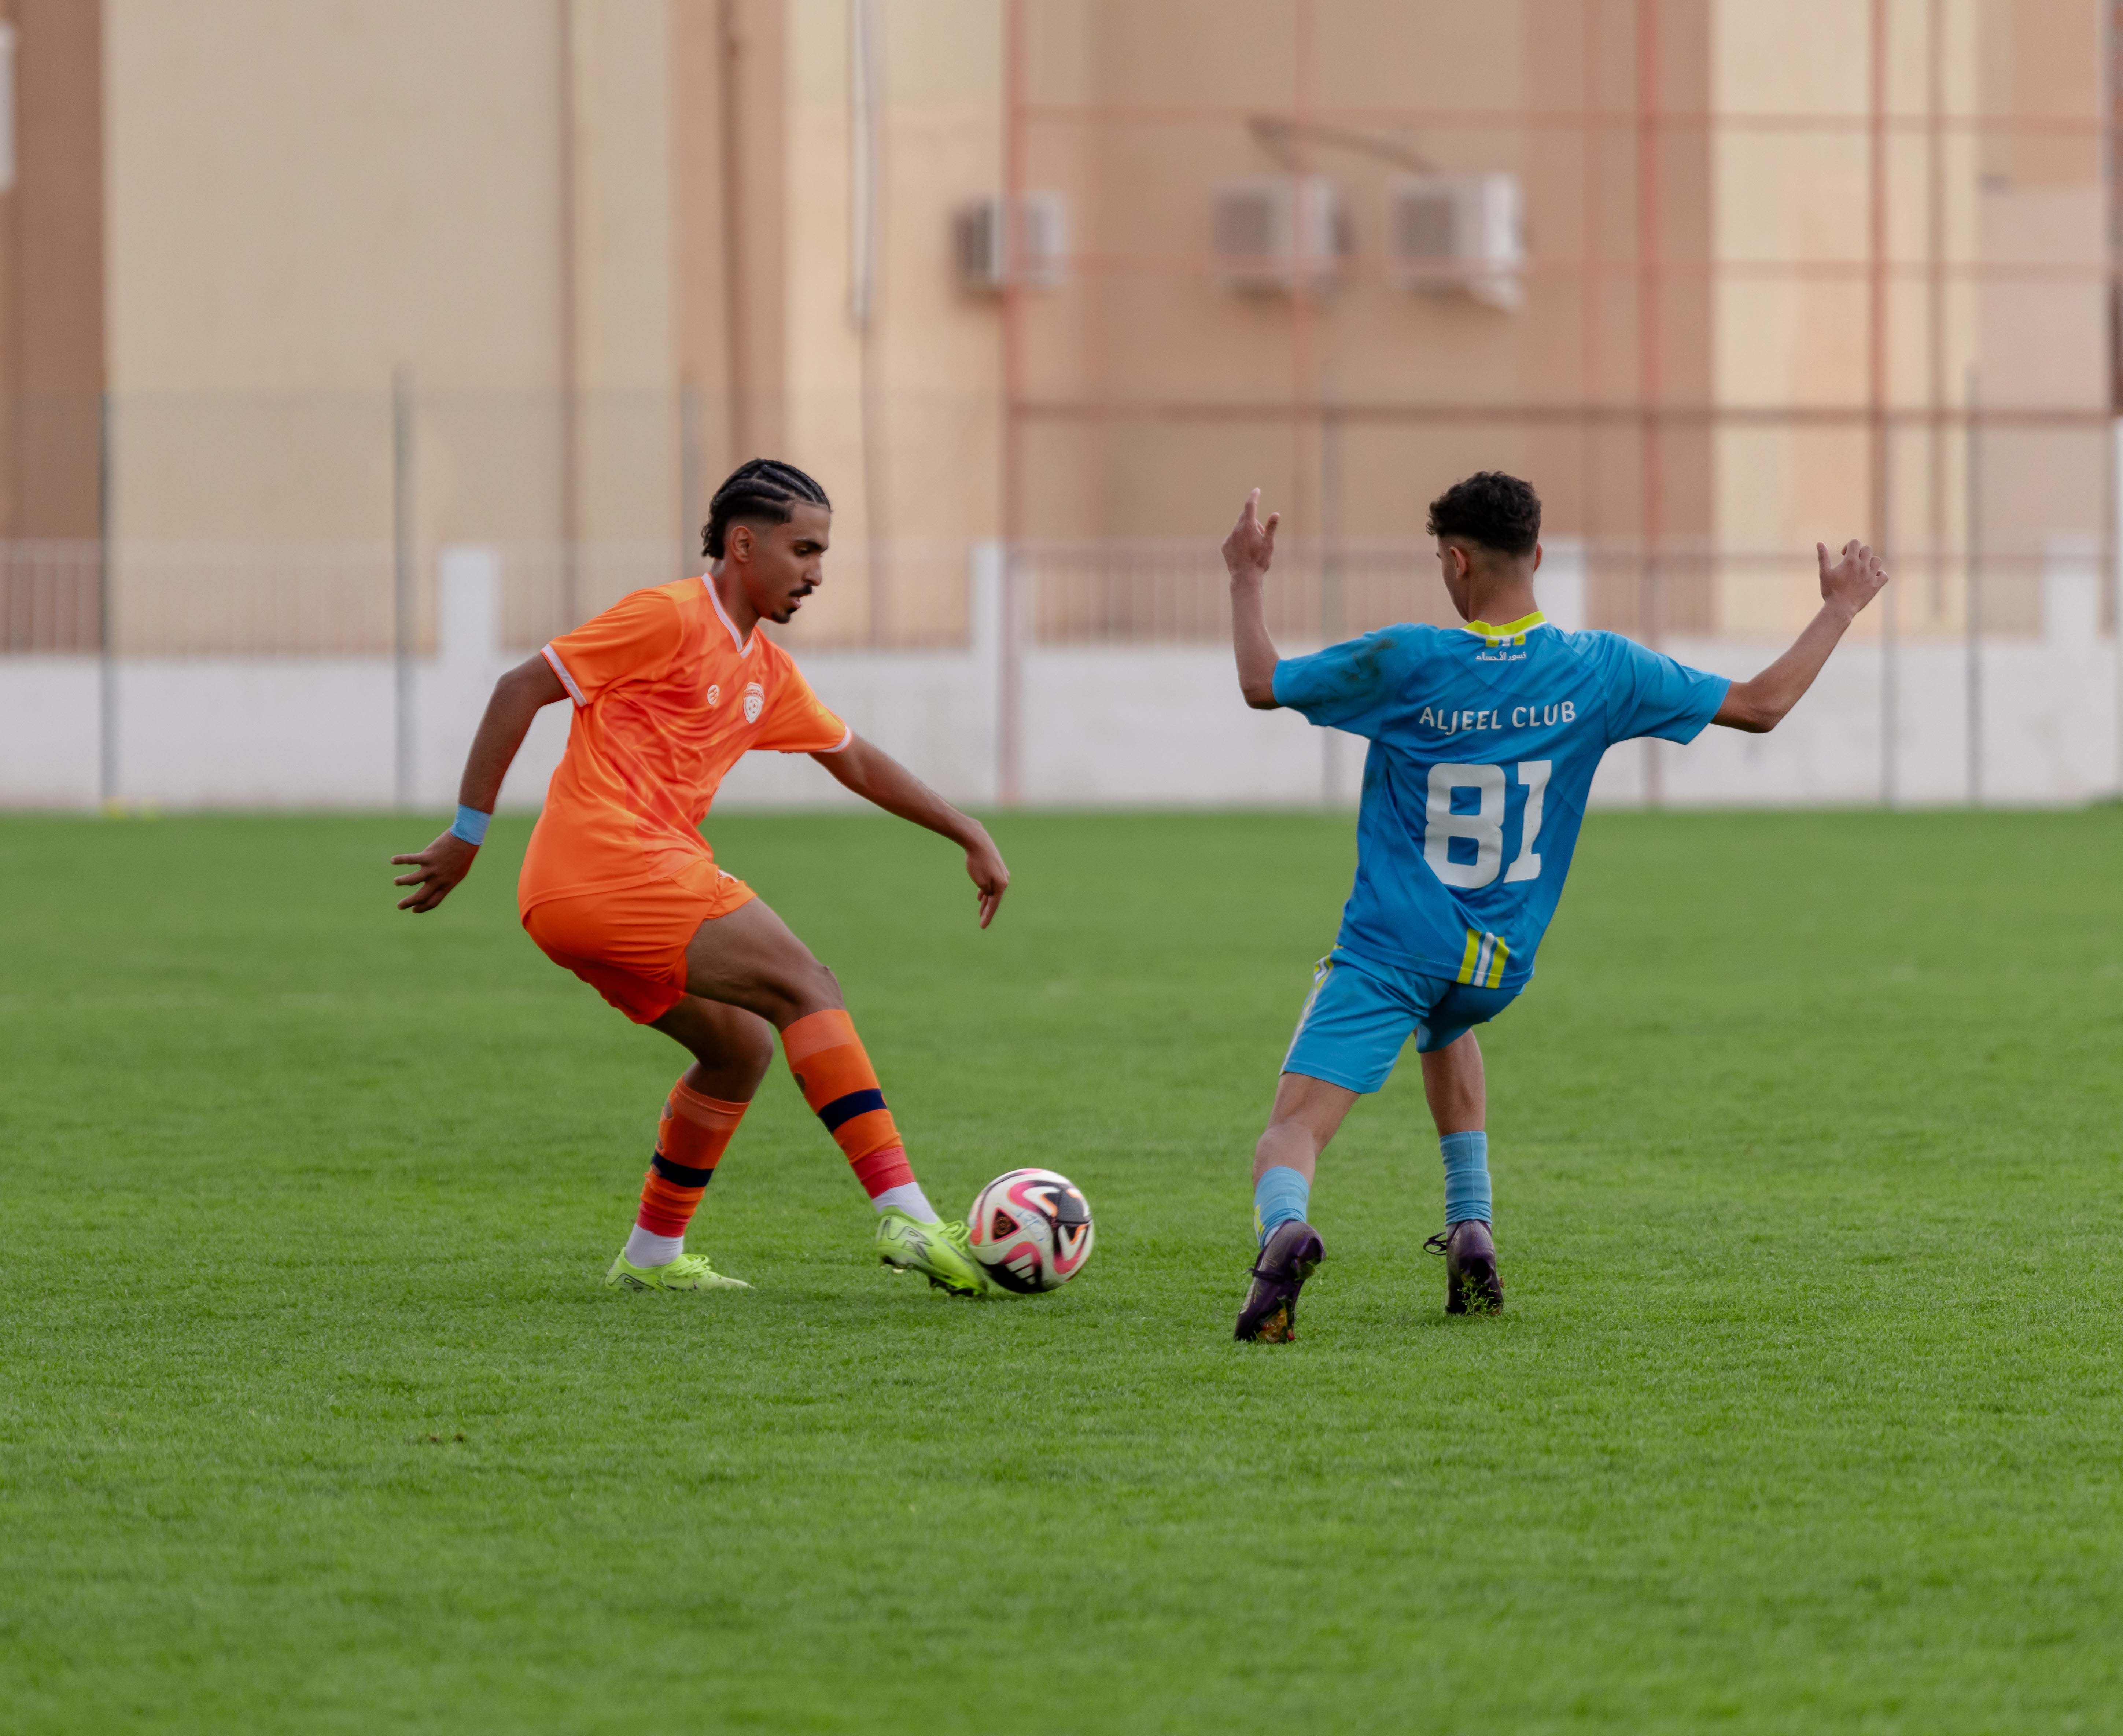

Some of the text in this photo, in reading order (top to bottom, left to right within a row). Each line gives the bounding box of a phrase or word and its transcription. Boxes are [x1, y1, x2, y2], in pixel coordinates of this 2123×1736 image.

[1508, 652, 1526, 661] نسور
[1419, 701, 1576, 735] ALJEEL CLUB
[1423, 760, 1552, 889] 81
